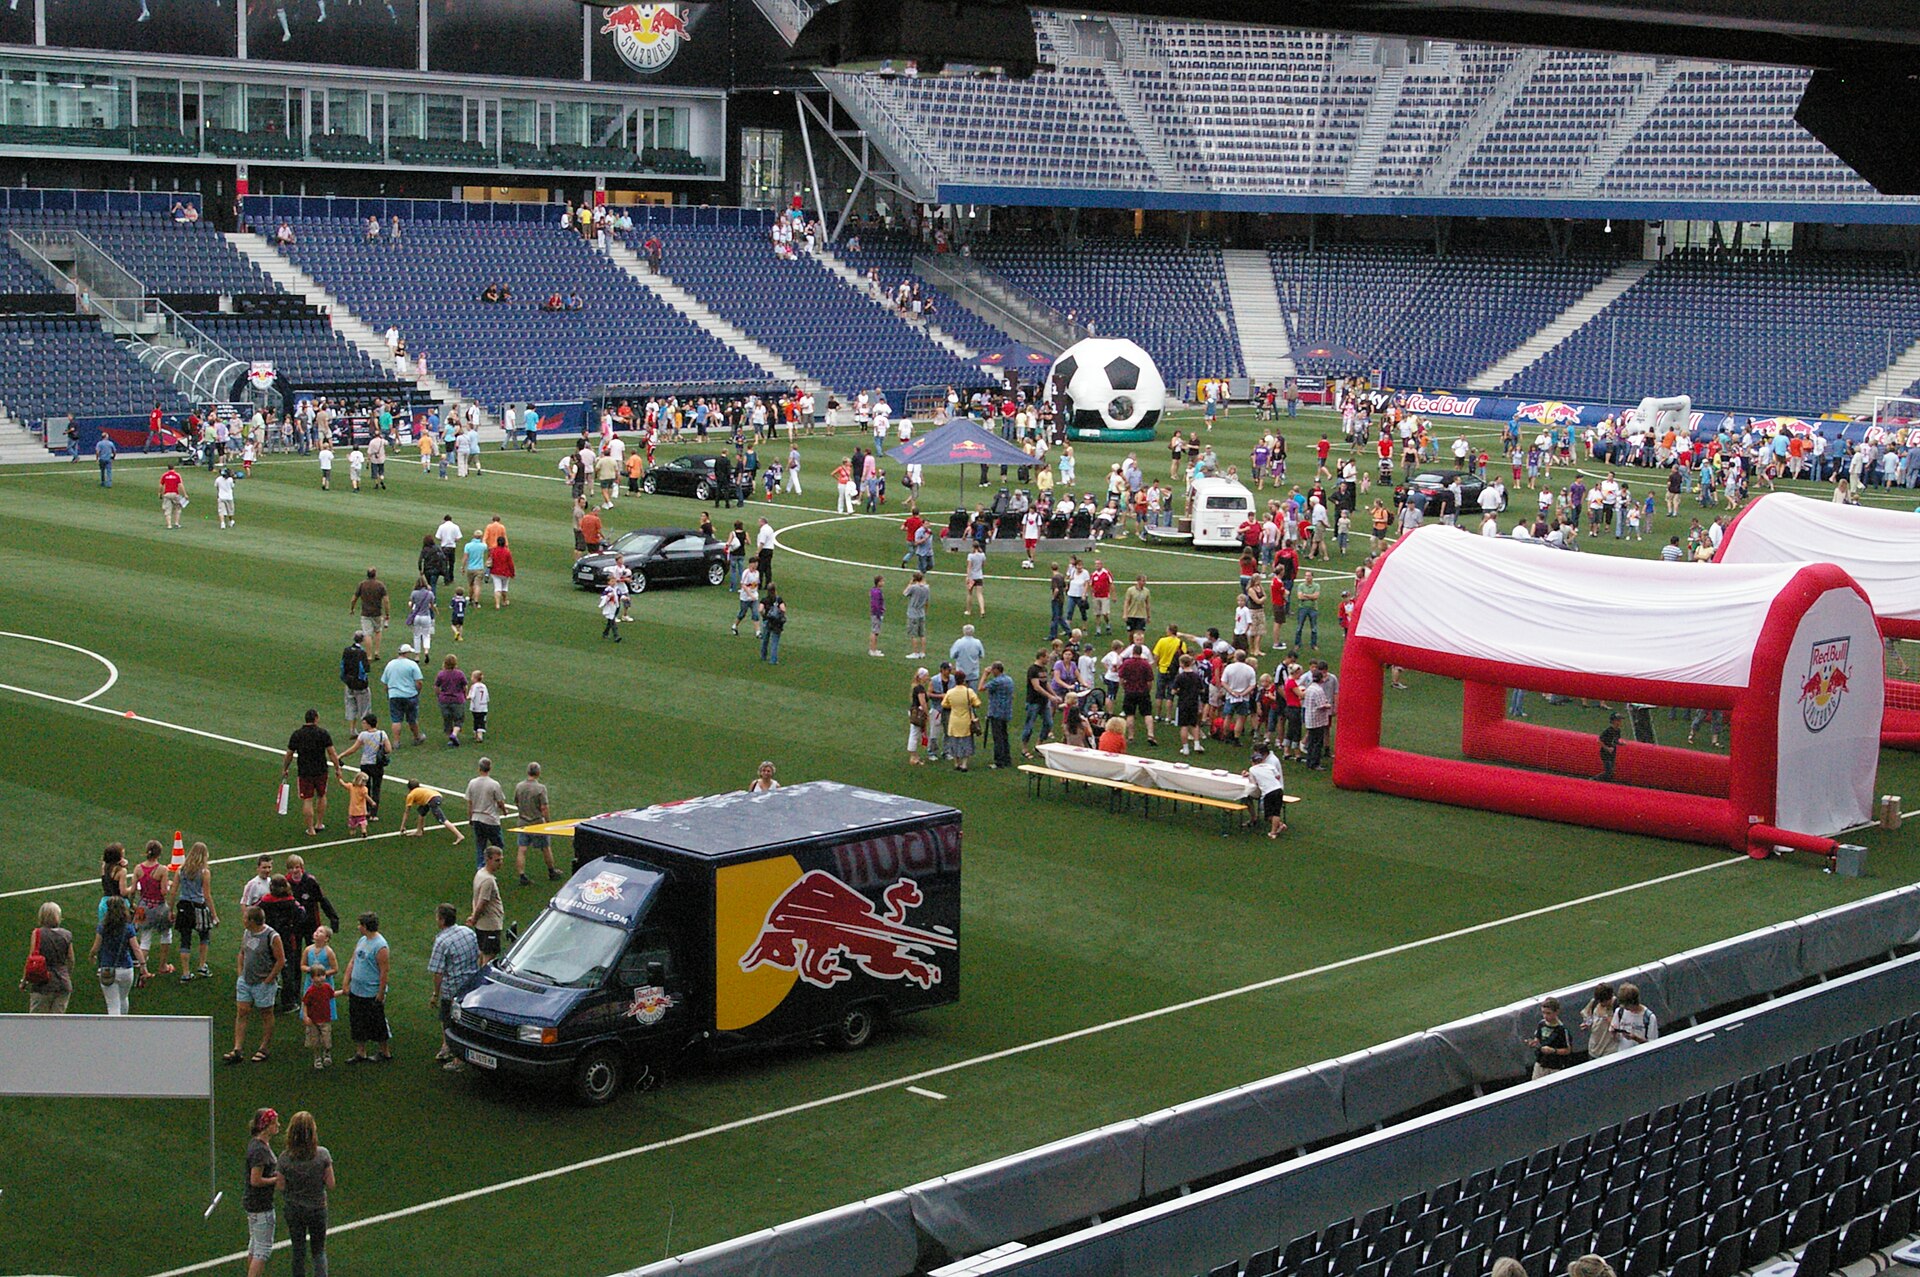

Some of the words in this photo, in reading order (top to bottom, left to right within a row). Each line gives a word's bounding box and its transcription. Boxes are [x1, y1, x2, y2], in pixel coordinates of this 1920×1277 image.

[620, 35, 671, 66] SALZBURG
[458, 602, 464, 613] 1
[479, 690, 485, 701] 7
